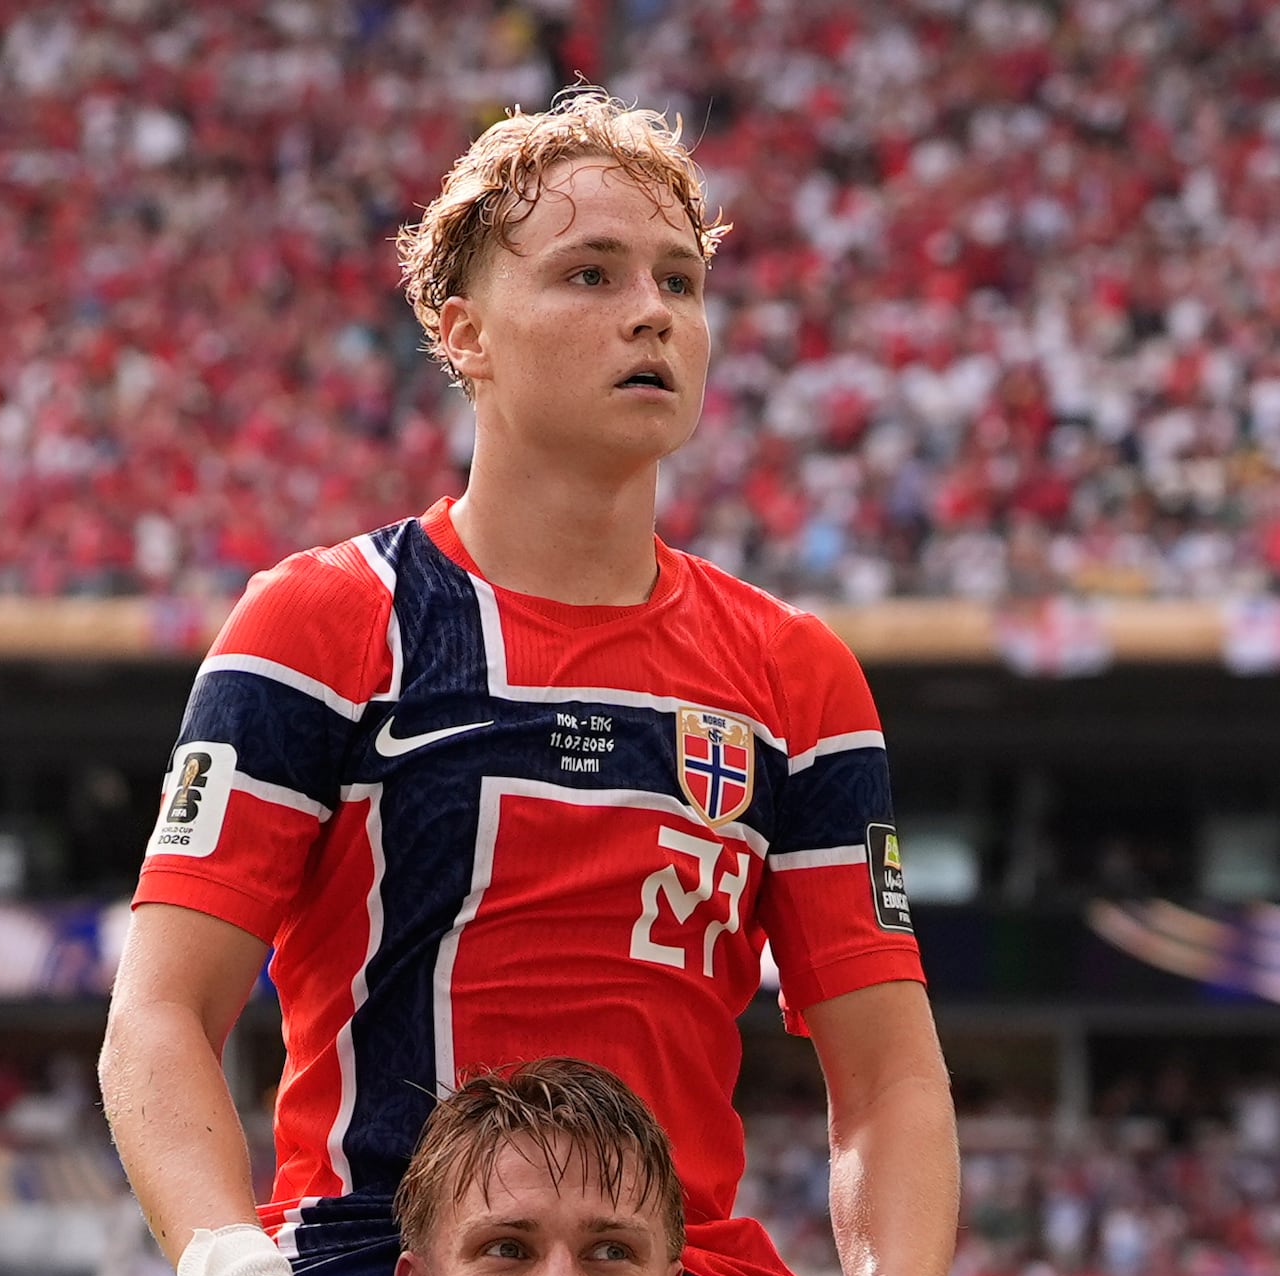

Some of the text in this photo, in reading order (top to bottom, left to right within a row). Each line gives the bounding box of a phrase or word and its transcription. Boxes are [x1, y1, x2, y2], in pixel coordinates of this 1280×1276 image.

[556, 713, 579, 730] NOR
[590, 715, 613, 733] ENG
[550, 732, 615, 752] 11.07.2026
[560, 755, 600, 773] MIAMI
[171, 808, 187, 817] FIFA
[158, 834, 190, 845] 2026
